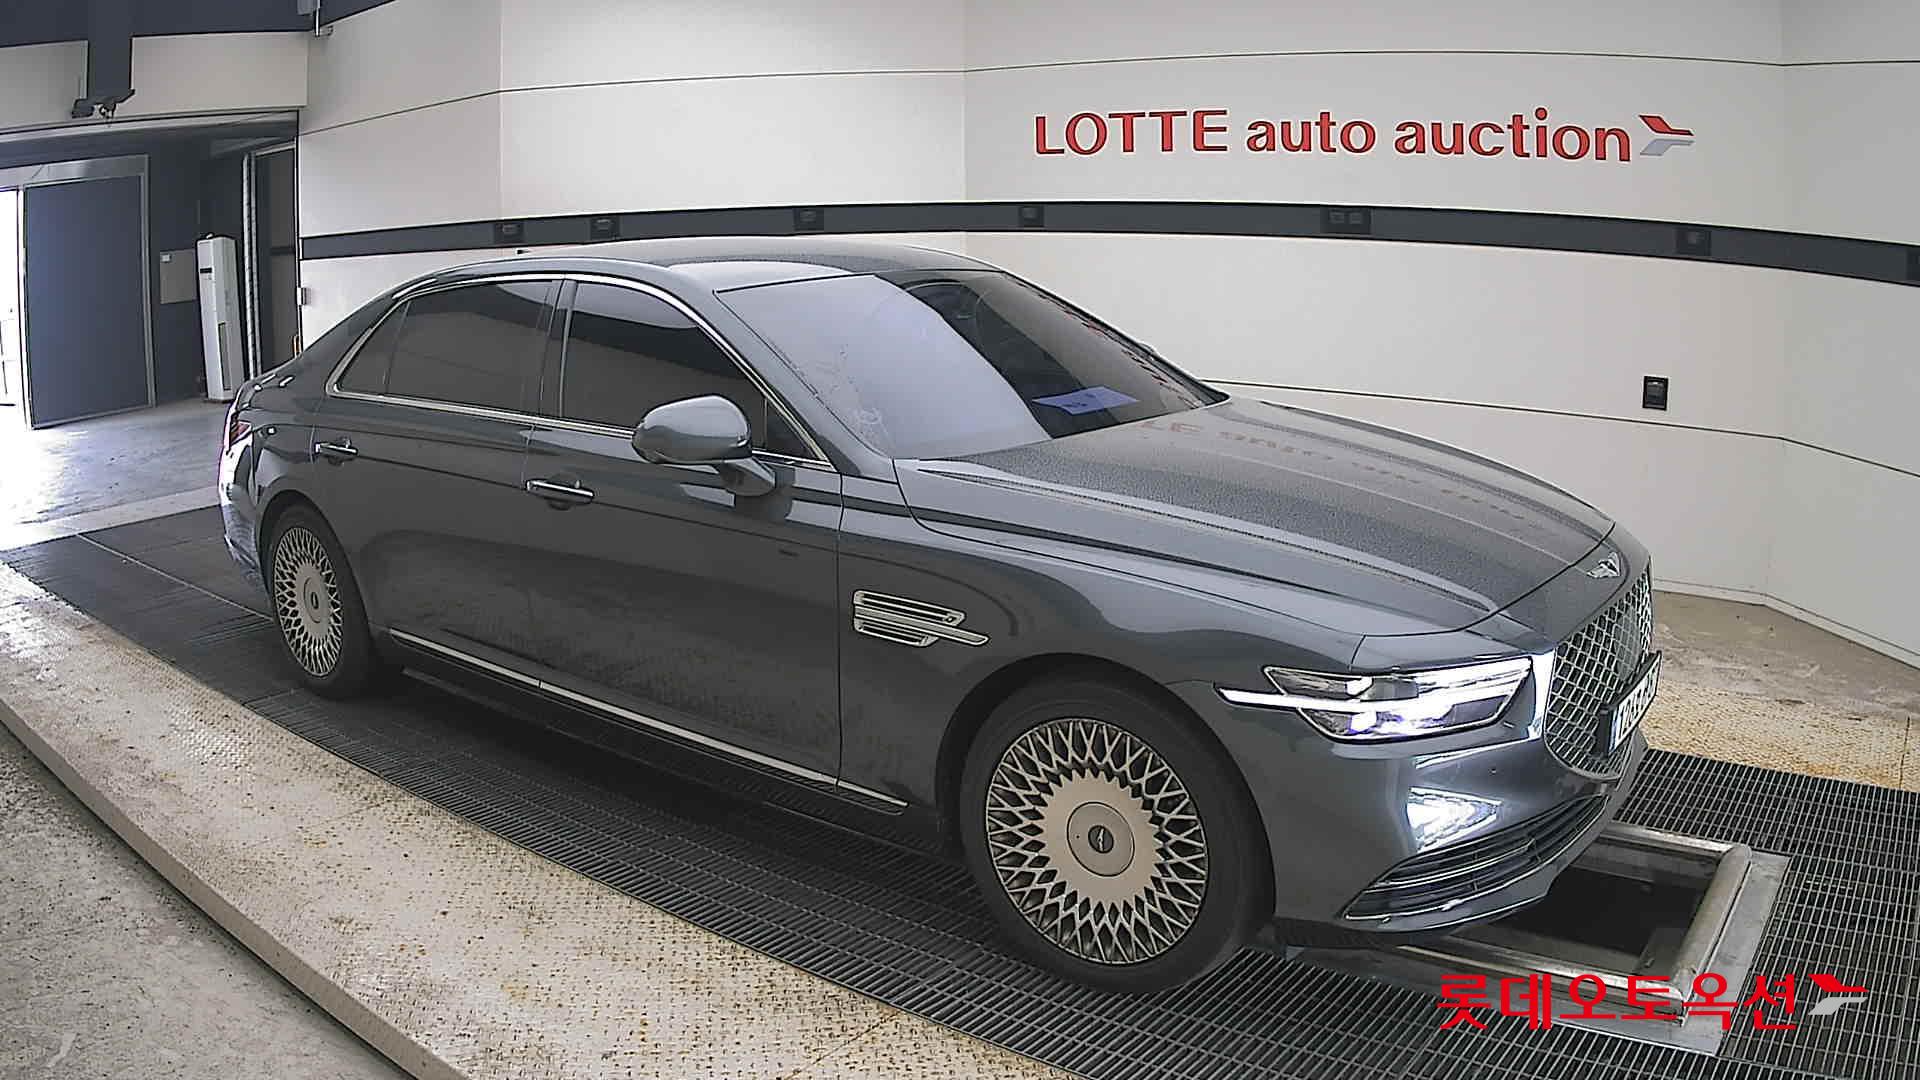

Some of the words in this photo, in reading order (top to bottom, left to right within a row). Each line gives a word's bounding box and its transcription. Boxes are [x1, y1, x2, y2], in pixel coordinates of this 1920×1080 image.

[1035, 109, 1228, 155] LOTTE
[1246, 111, 1377, 154] auto
[1393, 106, 1632, 162] auction
